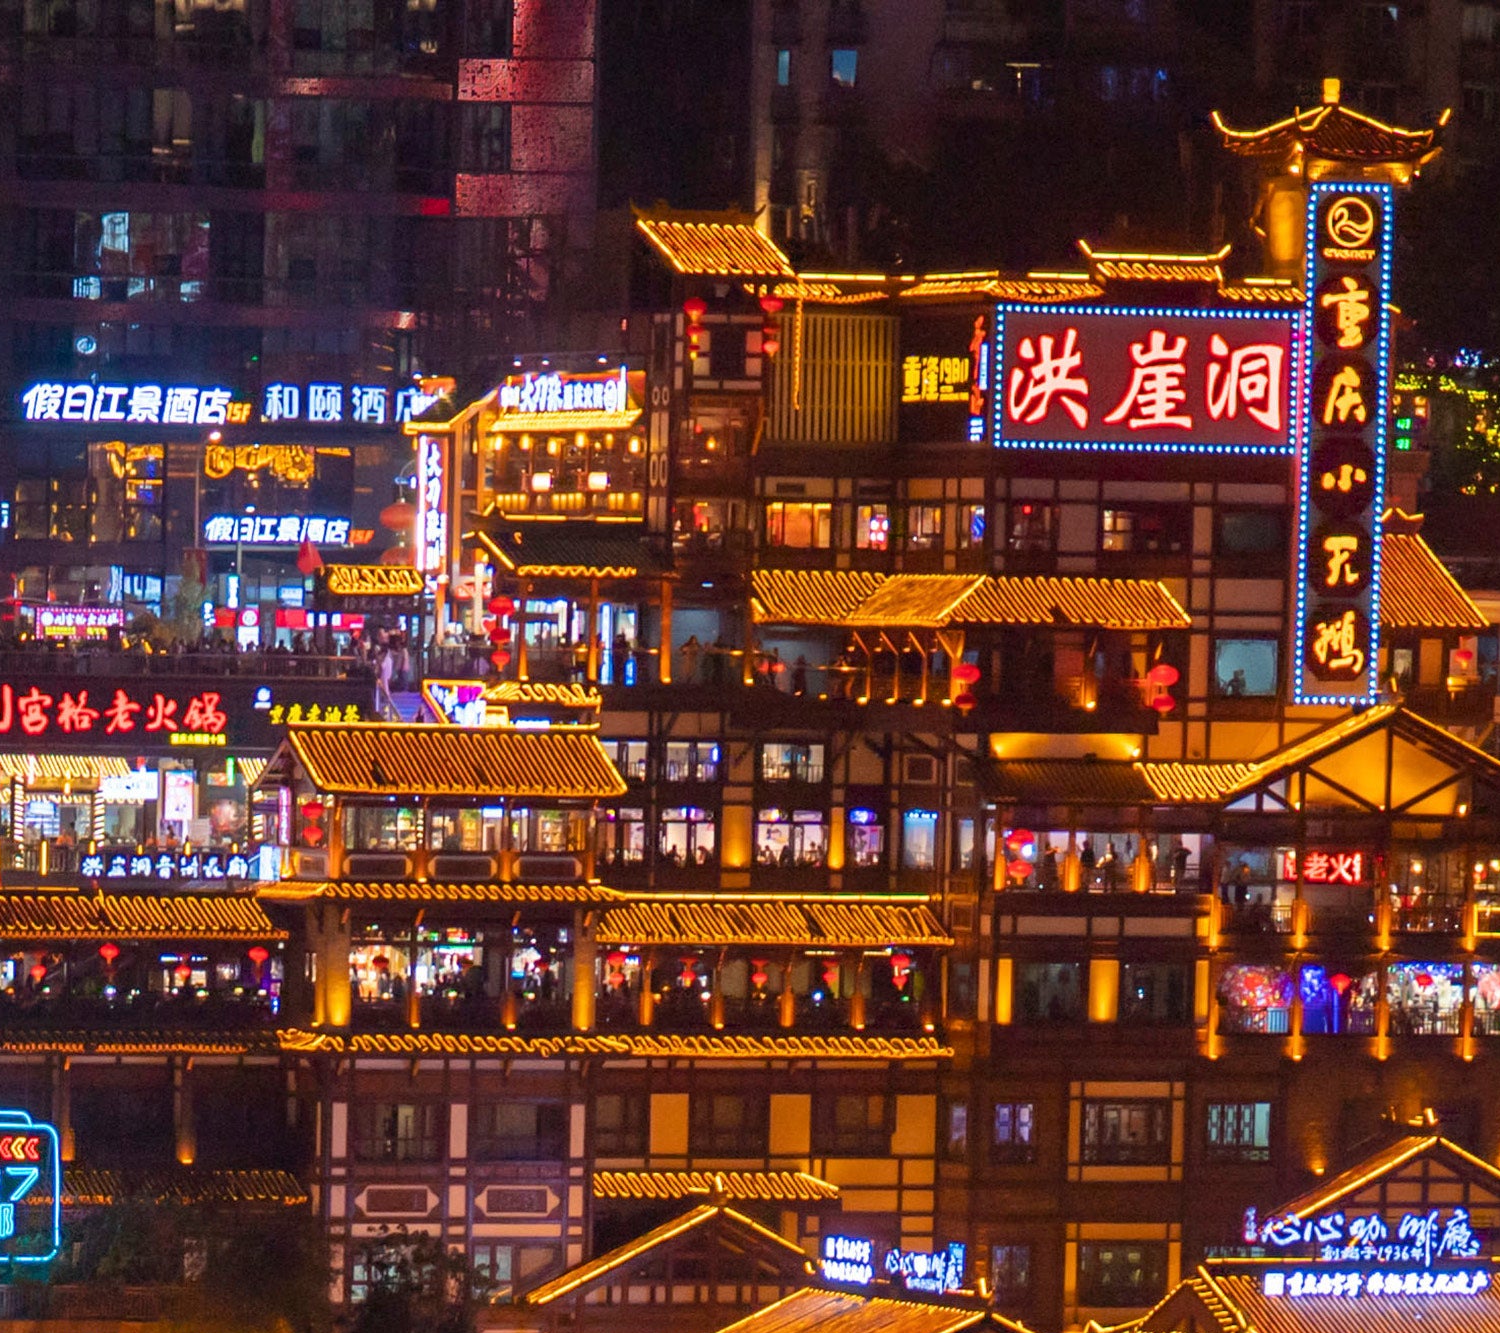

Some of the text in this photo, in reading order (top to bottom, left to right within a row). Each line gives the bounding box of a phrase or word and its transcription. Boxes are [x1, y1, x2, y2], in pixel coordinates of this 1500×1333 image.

[23, 383, 231, 424] 假日江景酒店
[1009, 327, 1284, 431] 洪崖洞
